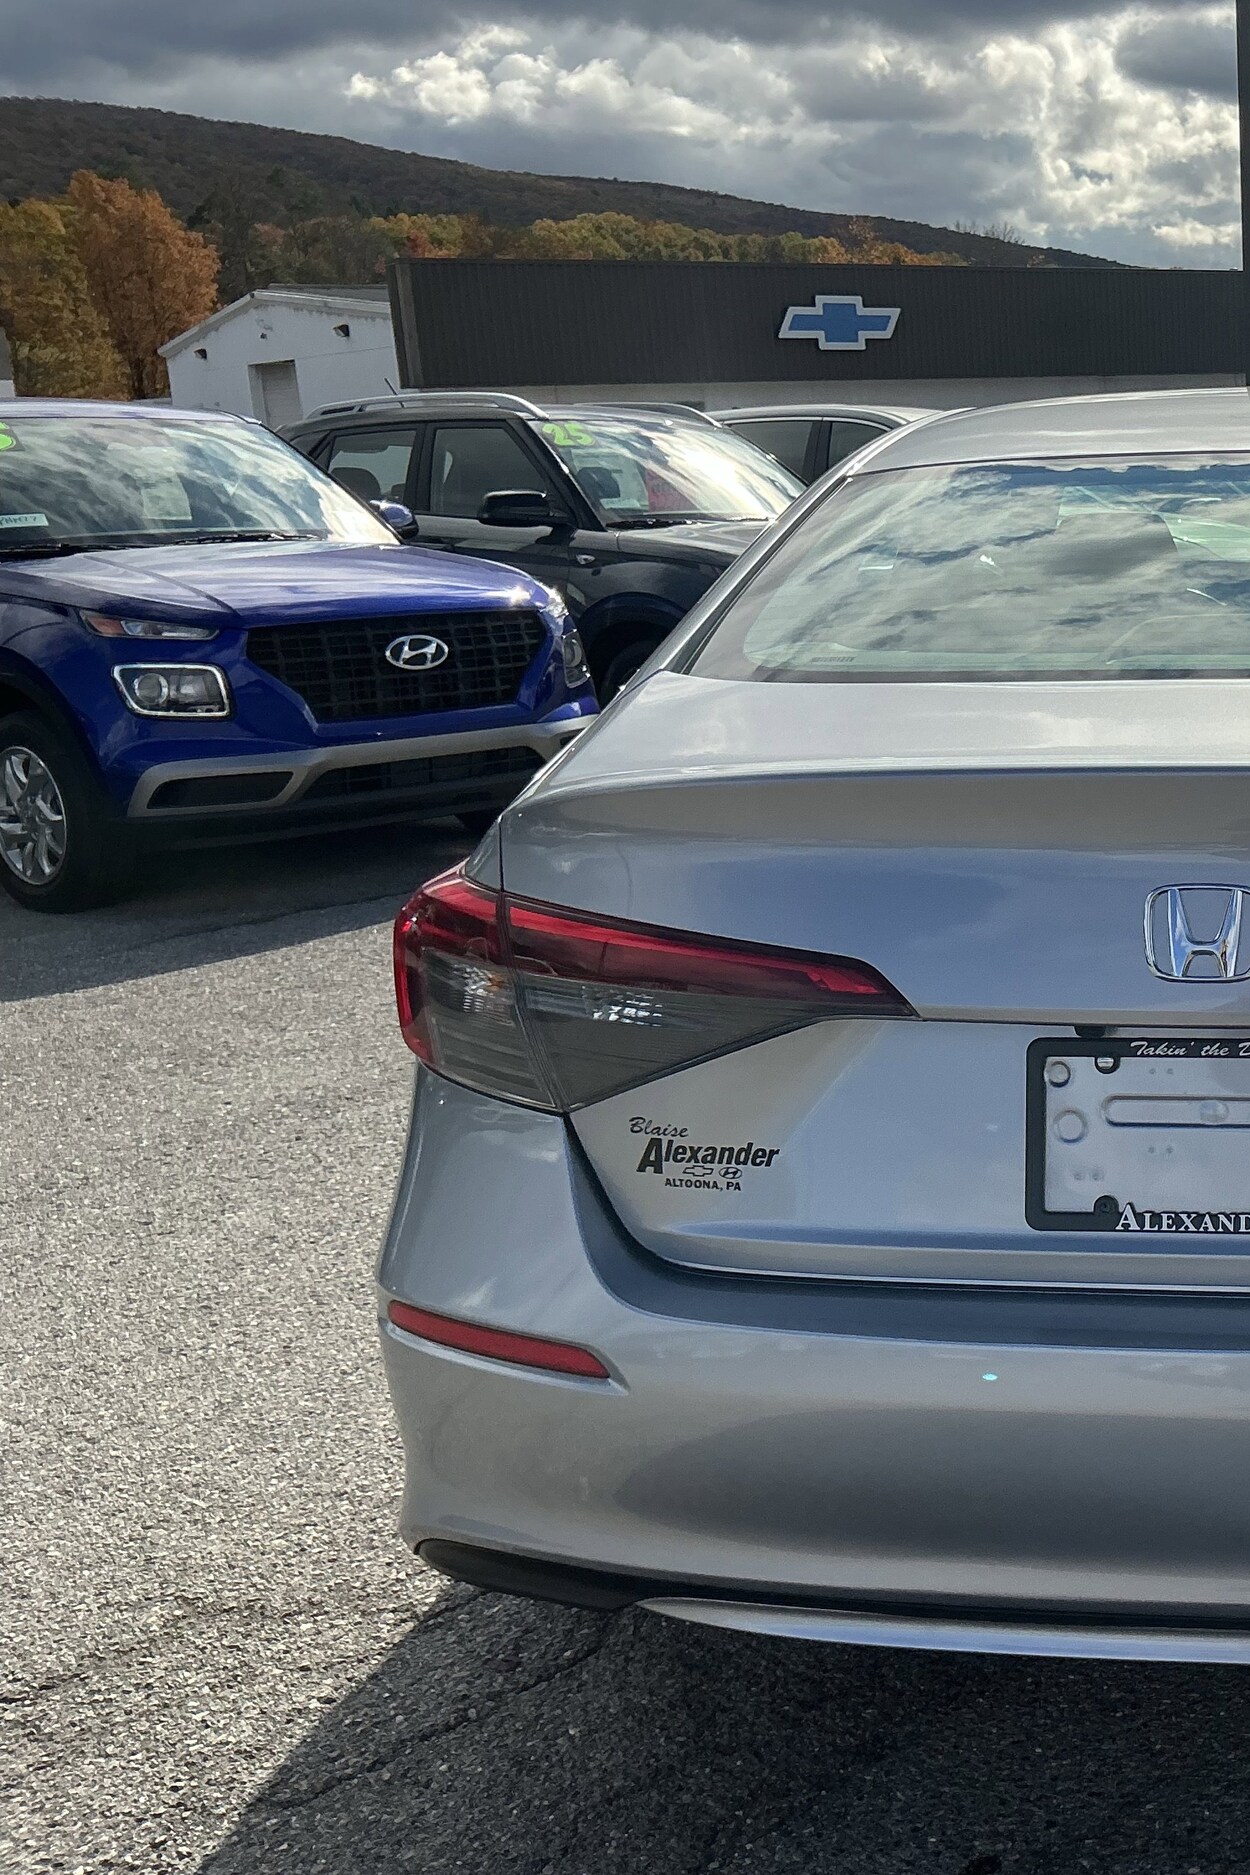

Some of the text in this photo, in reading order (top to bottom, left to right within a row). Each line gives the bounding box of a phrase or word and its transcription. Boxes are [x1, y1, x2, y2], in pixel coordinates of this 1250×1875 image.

[542, 422, 595, 447] 25
[1201, 1041, 1230, 1057] the
[628, 1116, 689, 1138] Blaise
[636, 1137, 781, 1175] Alexander
[664, 1178, 742, 1192] ALTOONA, PA
